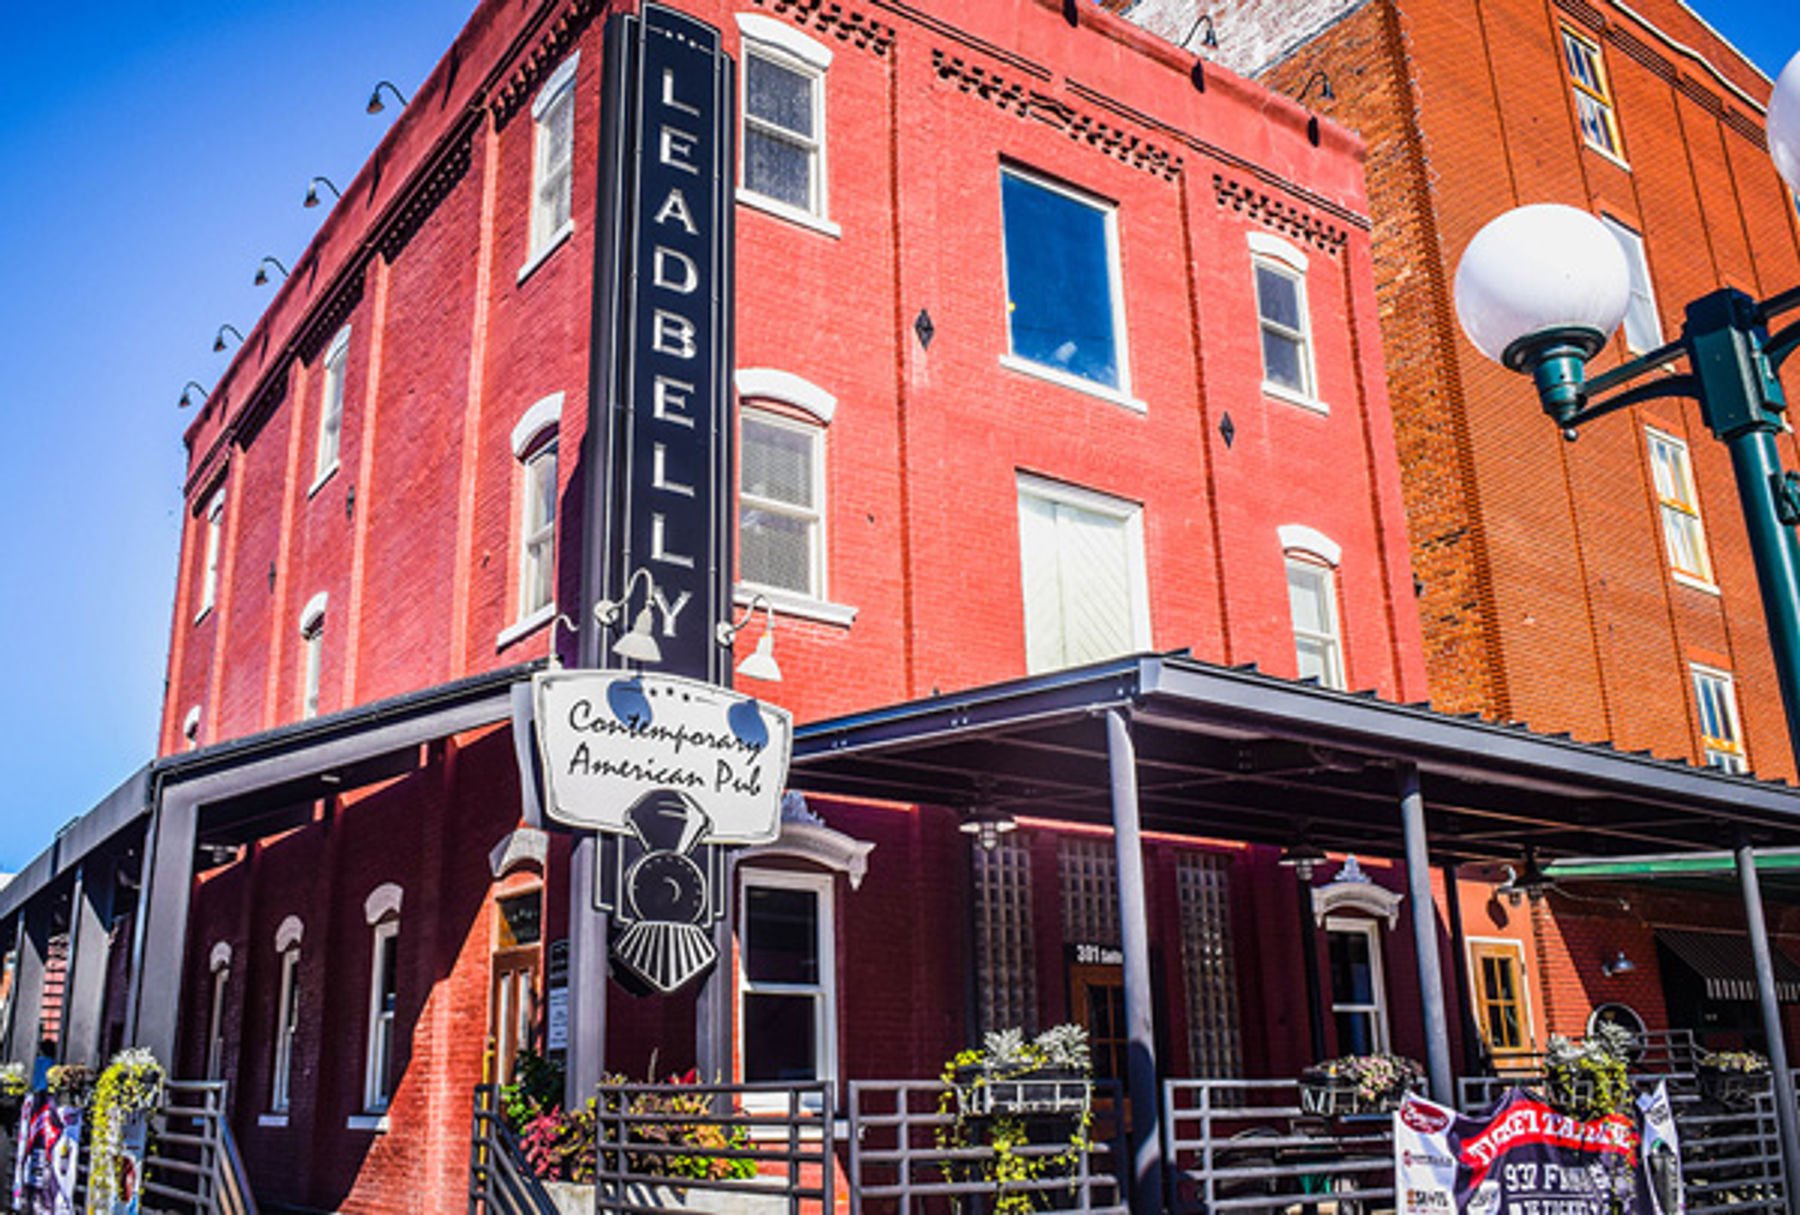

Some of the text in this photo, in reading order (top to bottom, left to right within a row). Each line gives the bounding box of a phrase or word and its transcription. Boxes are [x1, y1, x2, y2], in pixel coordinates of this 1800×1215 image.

[650, 66, 699, 639] LEADBELLY
[568, 699, 762, 766] Contemporary
[567, 741, 762, 797] American Pub
